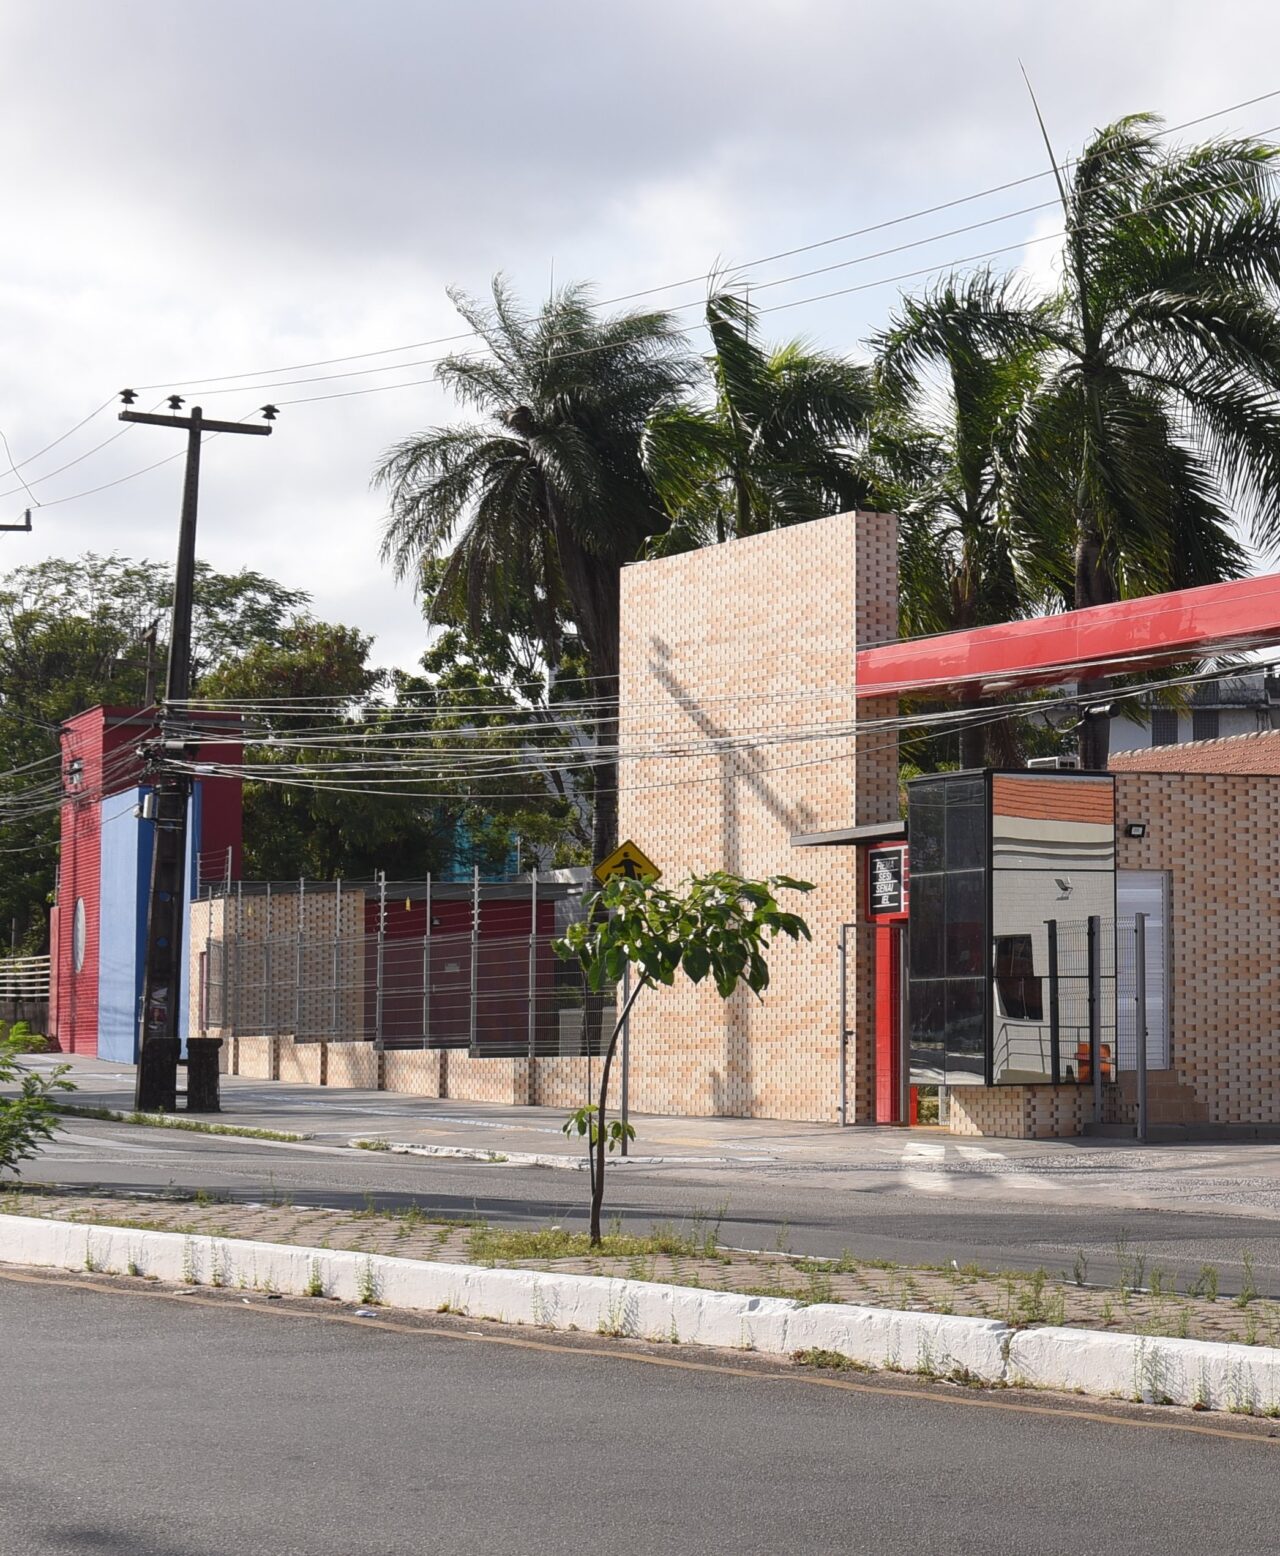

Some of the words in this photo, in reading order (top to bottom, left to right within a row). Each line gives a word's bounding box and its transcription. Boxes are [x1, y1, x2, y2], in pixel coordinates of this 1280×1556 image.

[878, 872, 892, 881] SESI
[875, 883, 894, 894] SENAI
[881, 895, 890, 904] IEL
